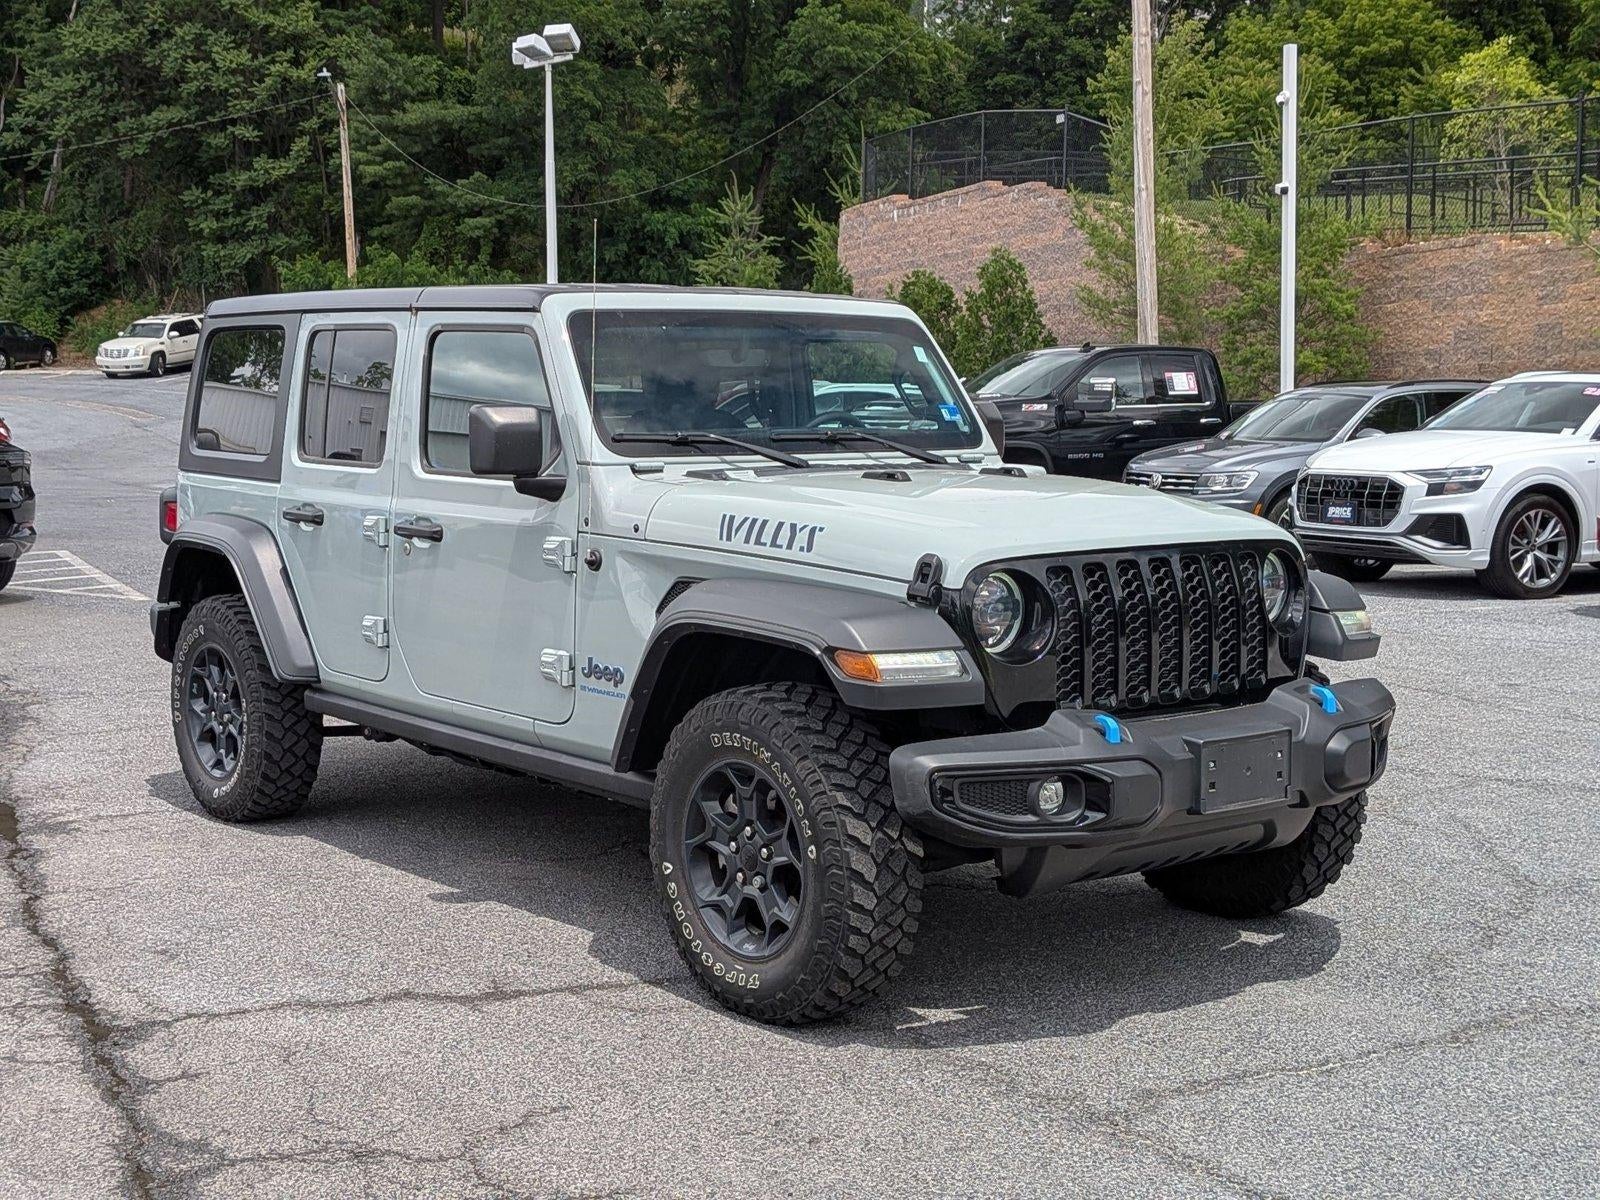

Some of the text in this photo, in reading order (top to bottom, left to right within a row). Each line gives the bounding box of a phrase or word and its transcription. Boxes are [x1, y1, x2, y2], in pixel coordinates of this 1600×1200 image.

[719, 513, 825, 553] WILLYS
[581, 657, 625, 688] Jeep
[710, 732, 814, 838] DESTINATION
